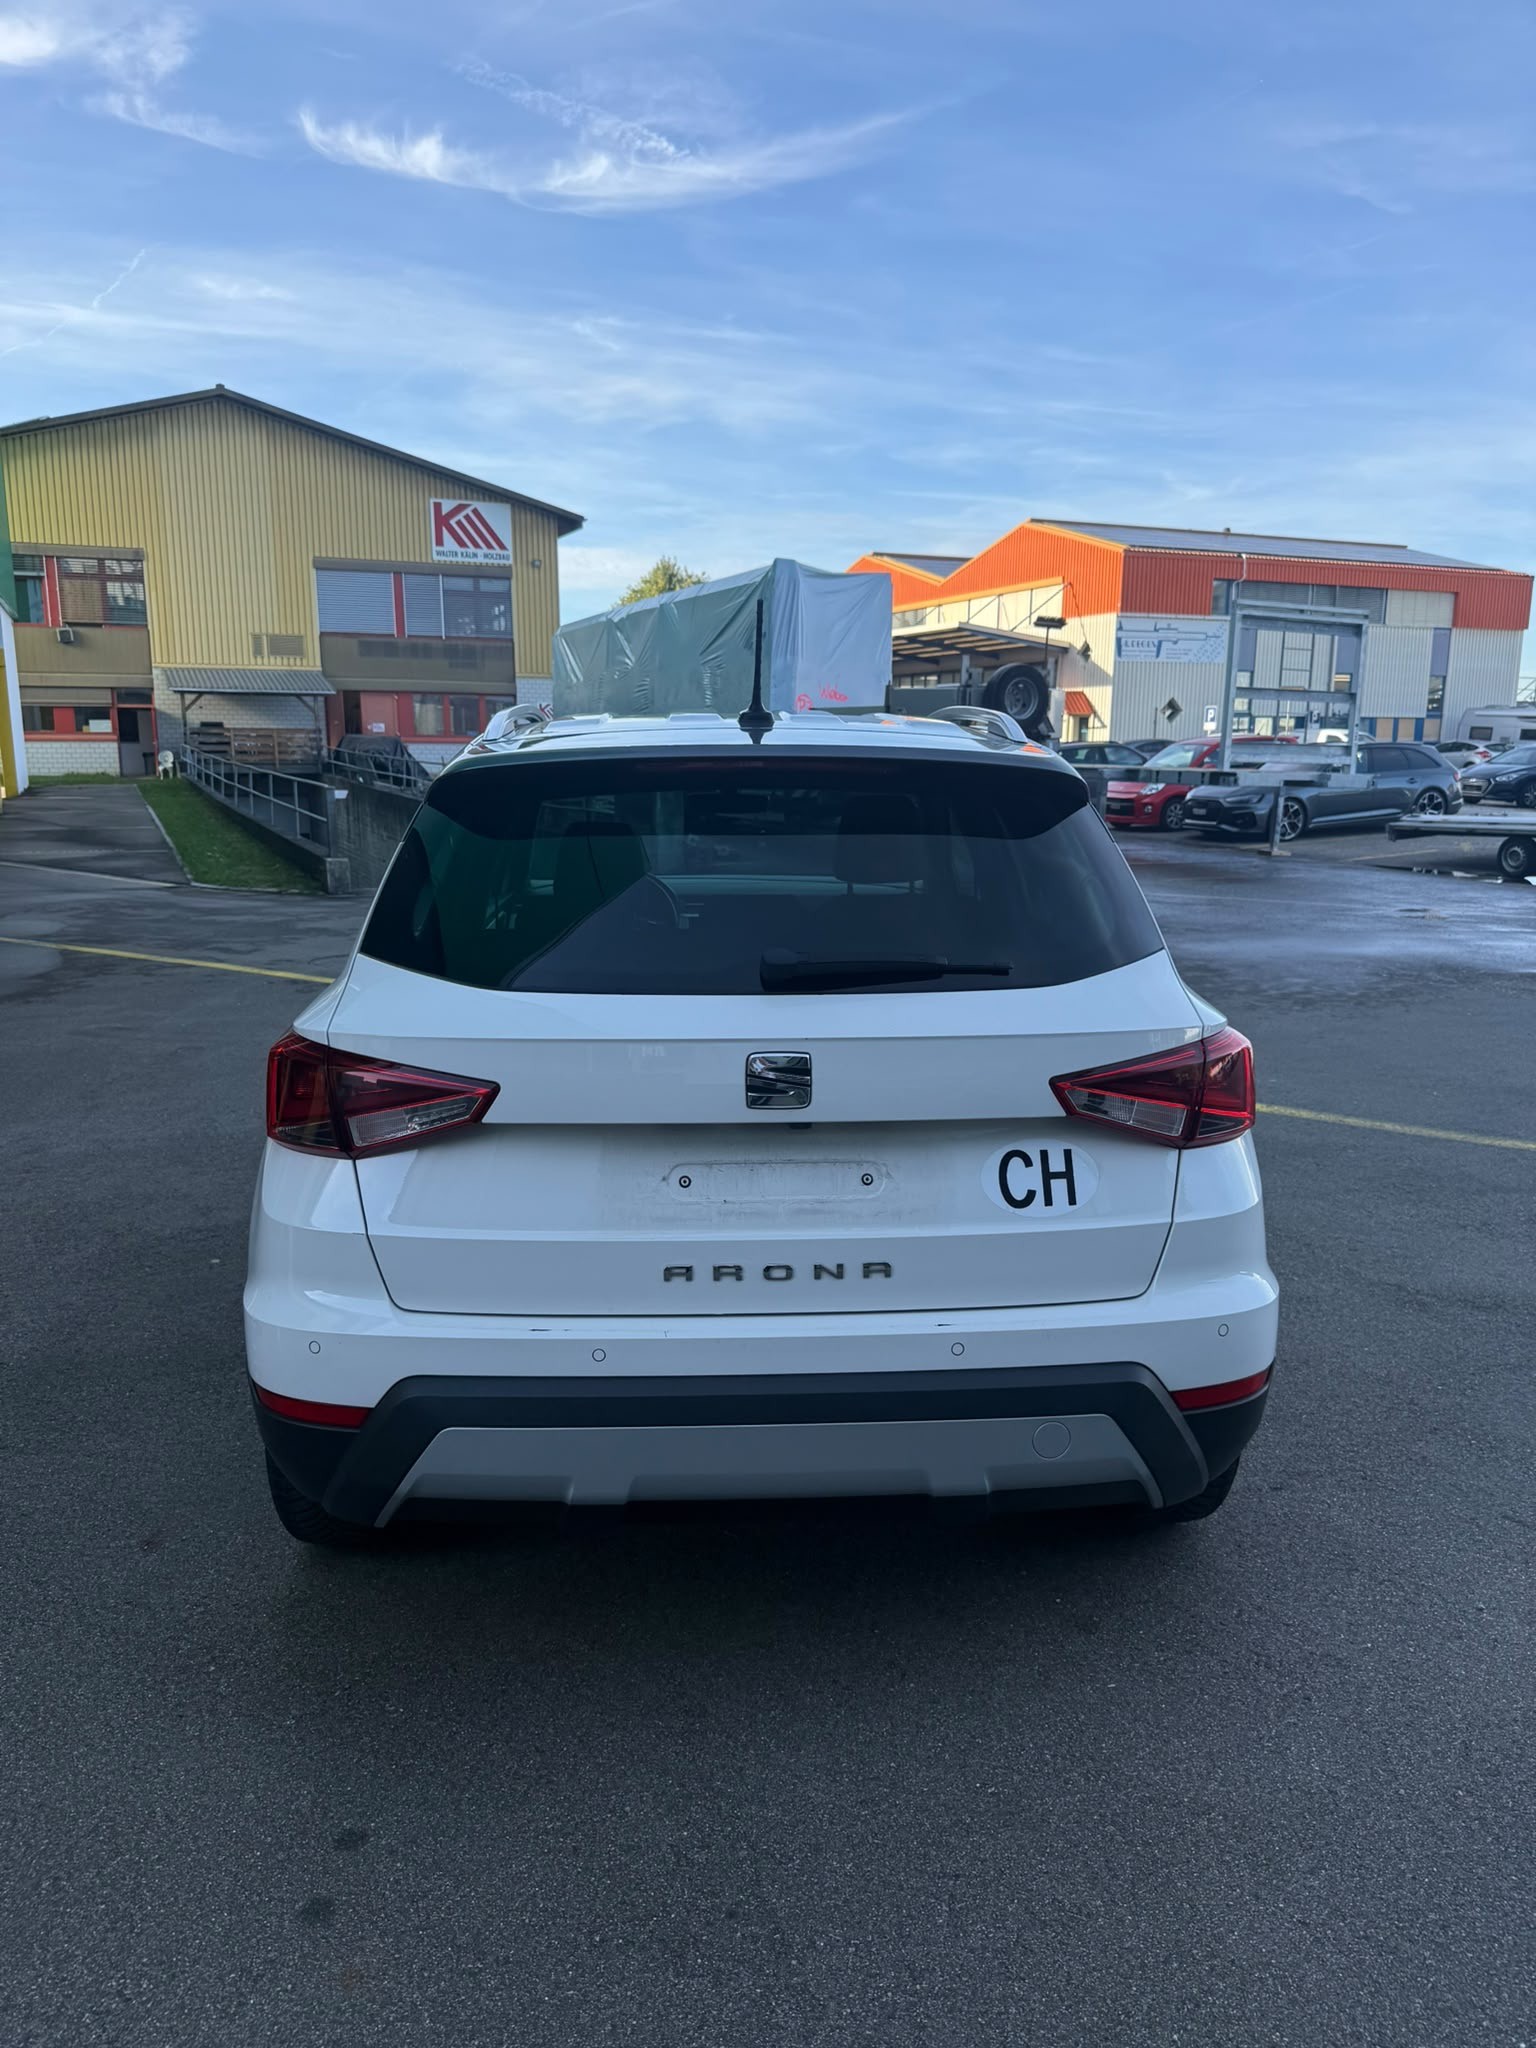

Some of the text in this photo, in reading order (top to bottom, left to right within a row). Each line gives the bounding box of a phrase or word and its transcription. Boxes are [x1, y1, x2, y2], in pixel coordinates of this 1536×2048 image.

[435, 549, 458, 558] WALTER
[483, 552, 511, 561] HOLZBAU
[997, 1148, 1078, 1210] CH
[663, 1261, 892, 1283] ARONA
